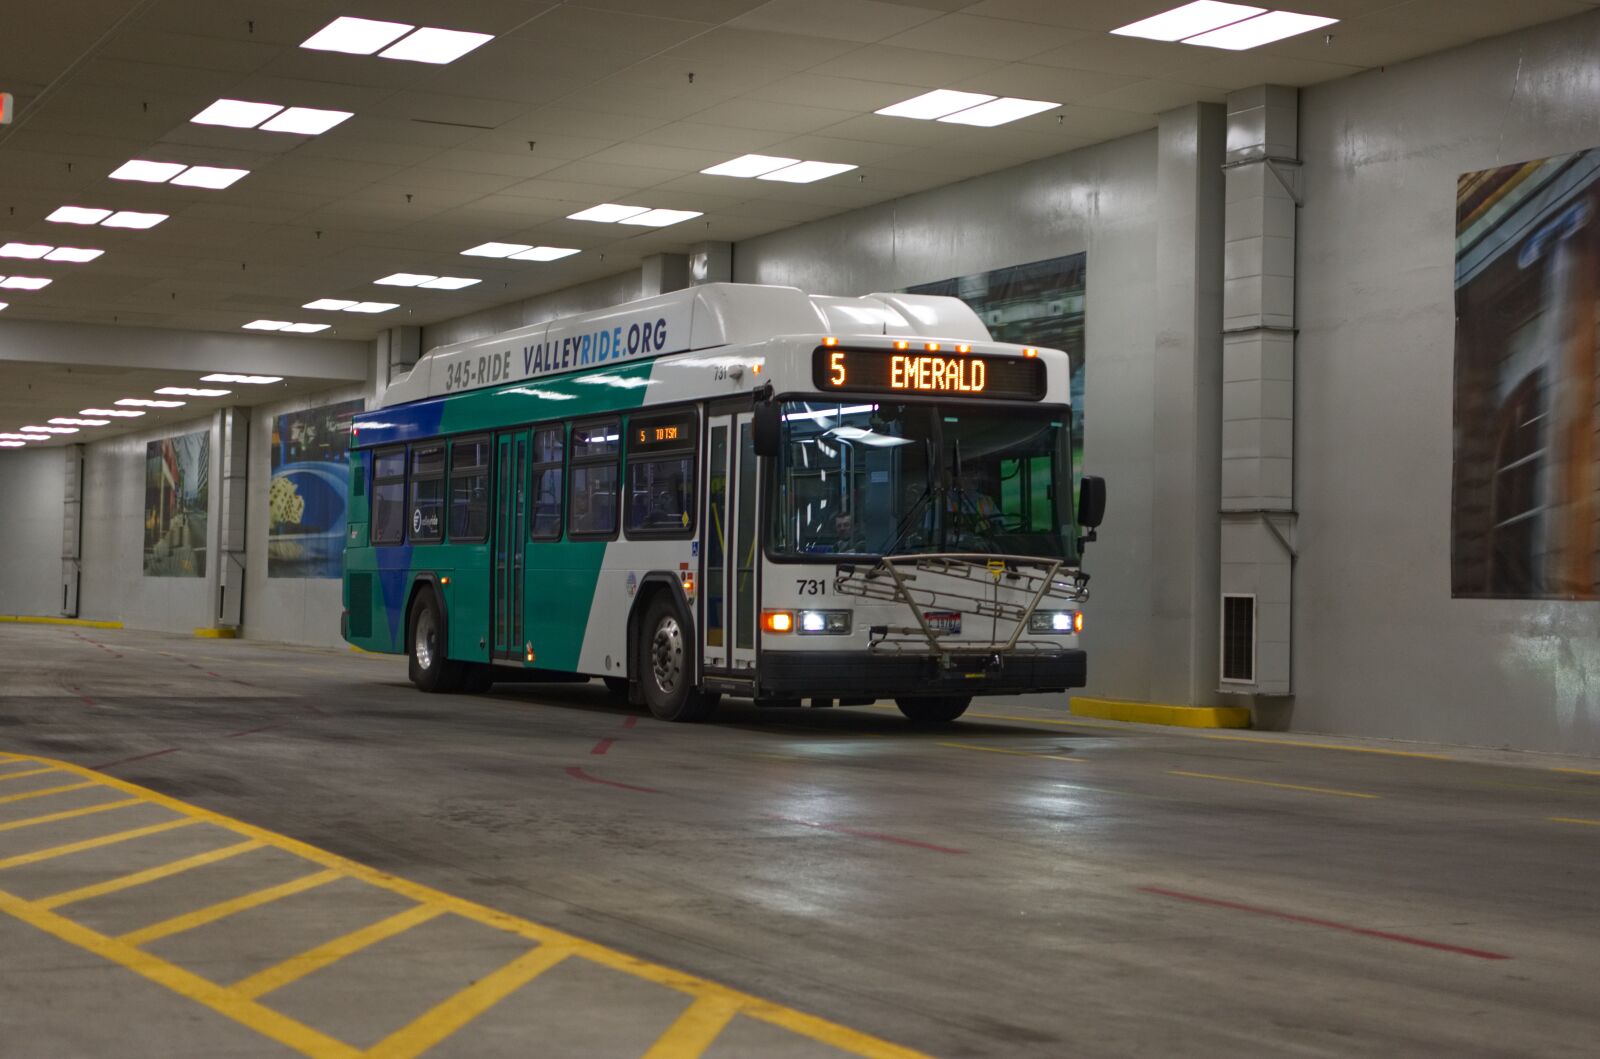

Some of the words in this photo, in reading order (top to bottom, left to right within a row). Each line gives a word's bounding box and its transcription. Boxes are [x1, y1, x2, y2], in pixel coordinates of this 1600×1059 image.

[446, 351, 511, 390] 345-RIDE
[524, 318, 667, 375] VALLEYRIDE.ORG
[714, 366, 727, 381] 731
[830, 353, 845, 386] 5
[891, 356, 985, 391] EMERALD
[640, 430, 646, 442] 5
[656, 428, 664, 440] TO
[796, 579, 826, 595] 731
